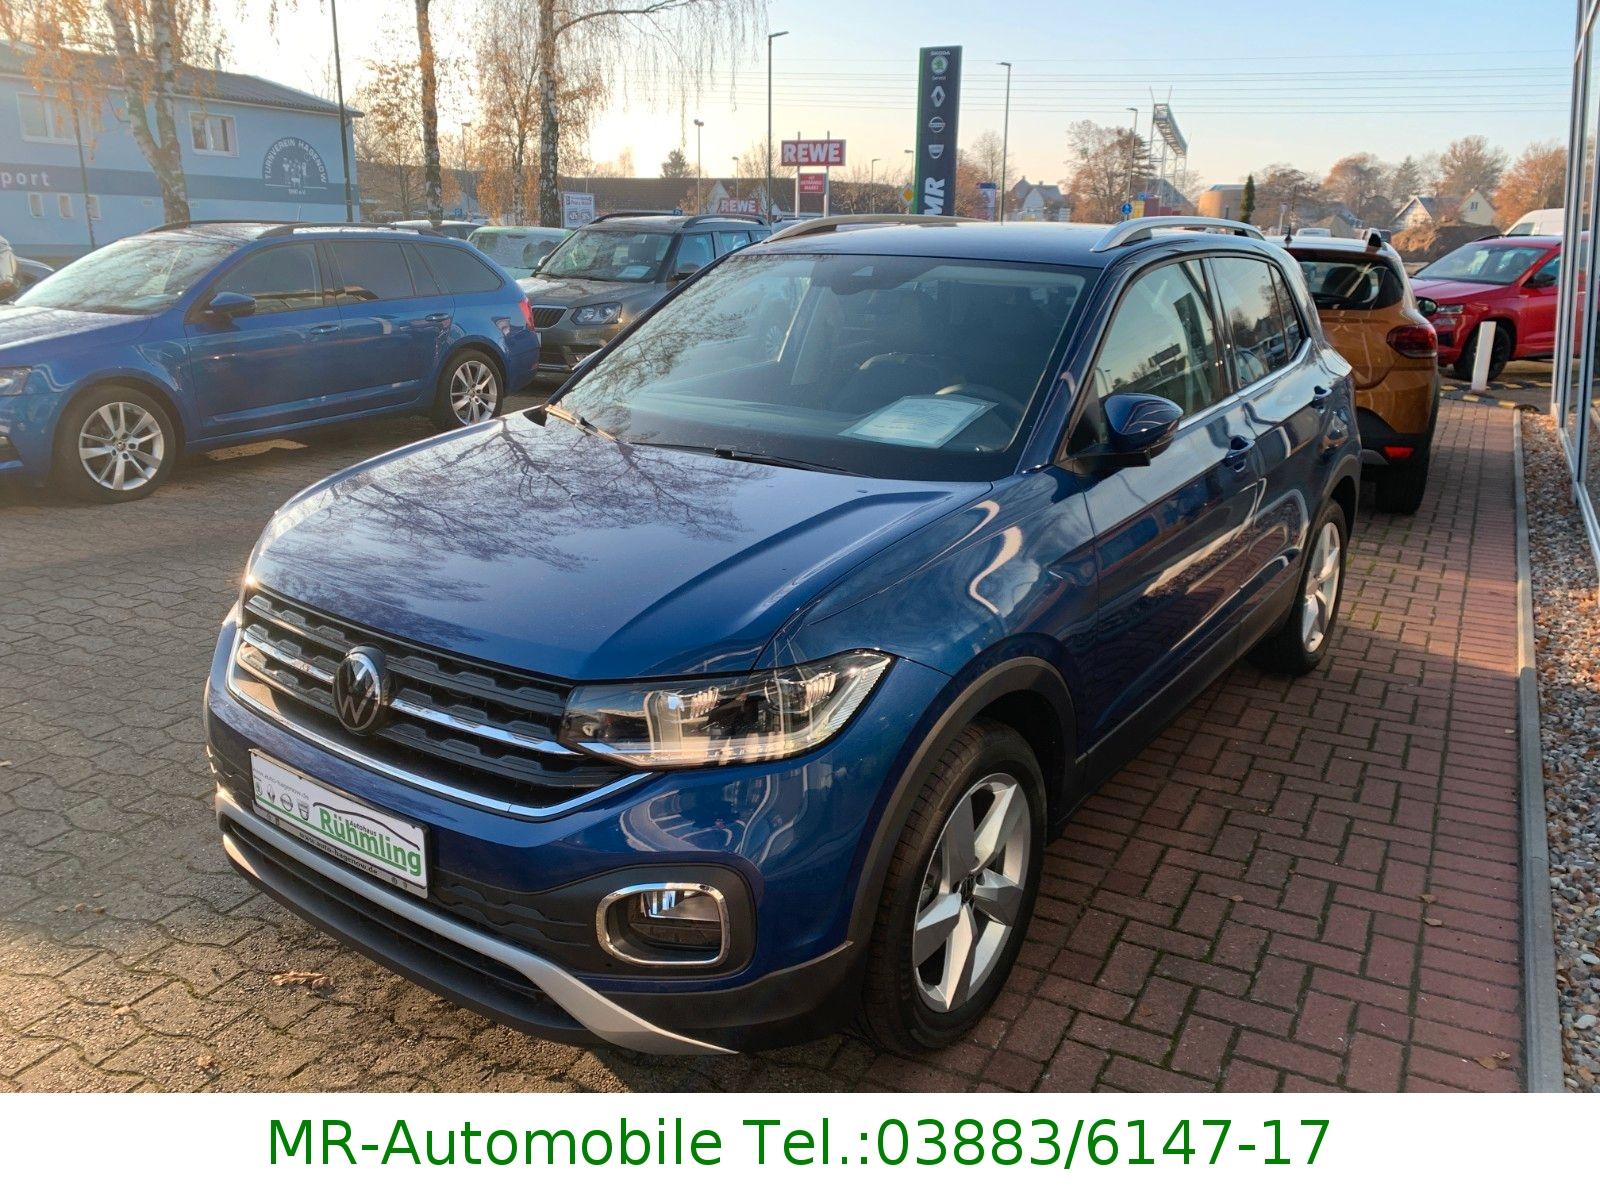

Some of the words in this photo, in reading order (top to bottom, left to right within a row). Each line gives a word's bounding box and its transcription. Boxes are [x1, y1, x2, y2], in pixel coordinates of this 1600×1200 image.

[783, 143, 841, 163] REWE
[1, 171, 50, 189] port
[720, 200, 756, 212] REWE
[349, 820, 377, 837] Autohaus
[319, 807, 421, 876] Rühmling
